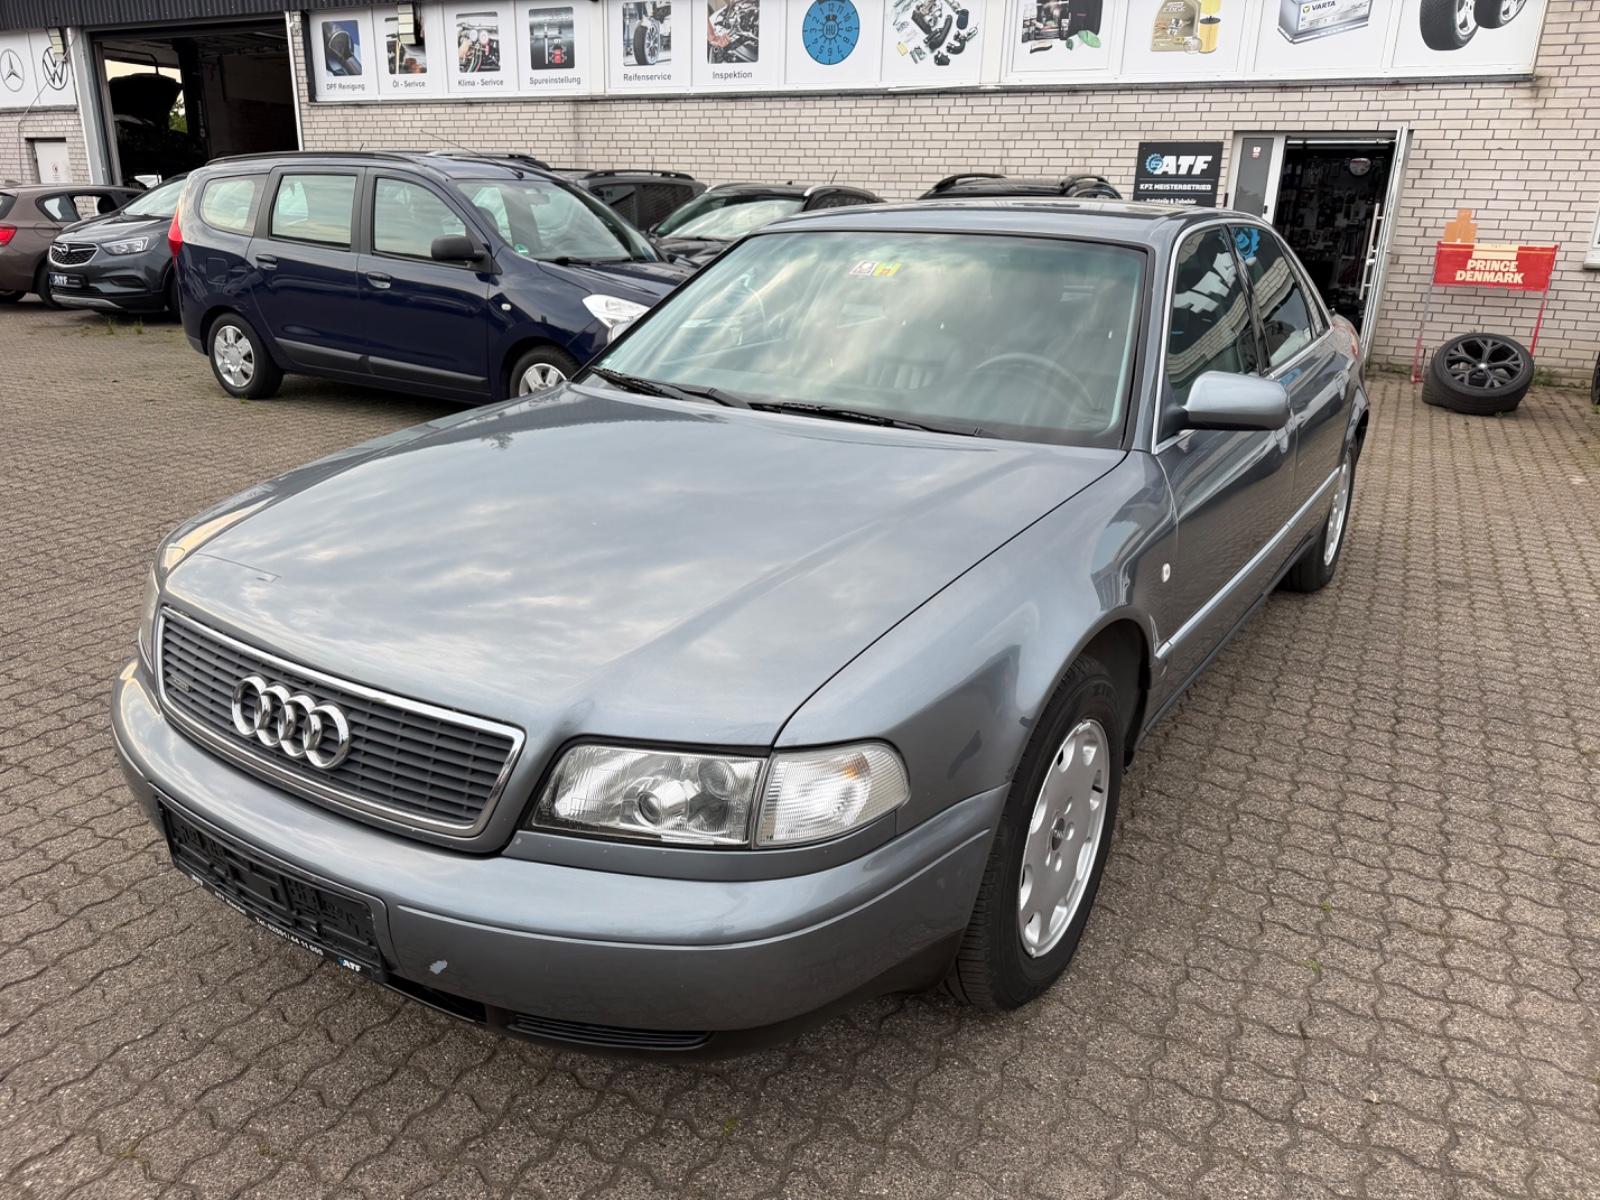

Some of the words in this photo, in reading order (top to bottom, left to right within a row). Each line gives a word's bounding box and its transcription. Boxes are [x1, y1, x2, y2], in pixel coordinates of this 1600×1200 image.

[1311, 0, 1336, 11] VARTA
[826, 25, 836, 35] HU
[623, 73, 672, 82] Reifenservice
[712, 71, 753, 80] Inspektion
[457, 79, 476, 87] Klima
[529, 76, 581, 86] Spureinstellung
[326, 83, 338, 91] DPF
[338, 82, 366, 92] Reinigung
[1154, 156, 1212, 175] ATF
[1139, 183, 1153, 191] KFZ
[1154, 183, 1212, 191] MEISTERBETRIEB
[1466, 259, 1519, 272] PRINCE
[1455, 270, 1525, 284] DENMARK
